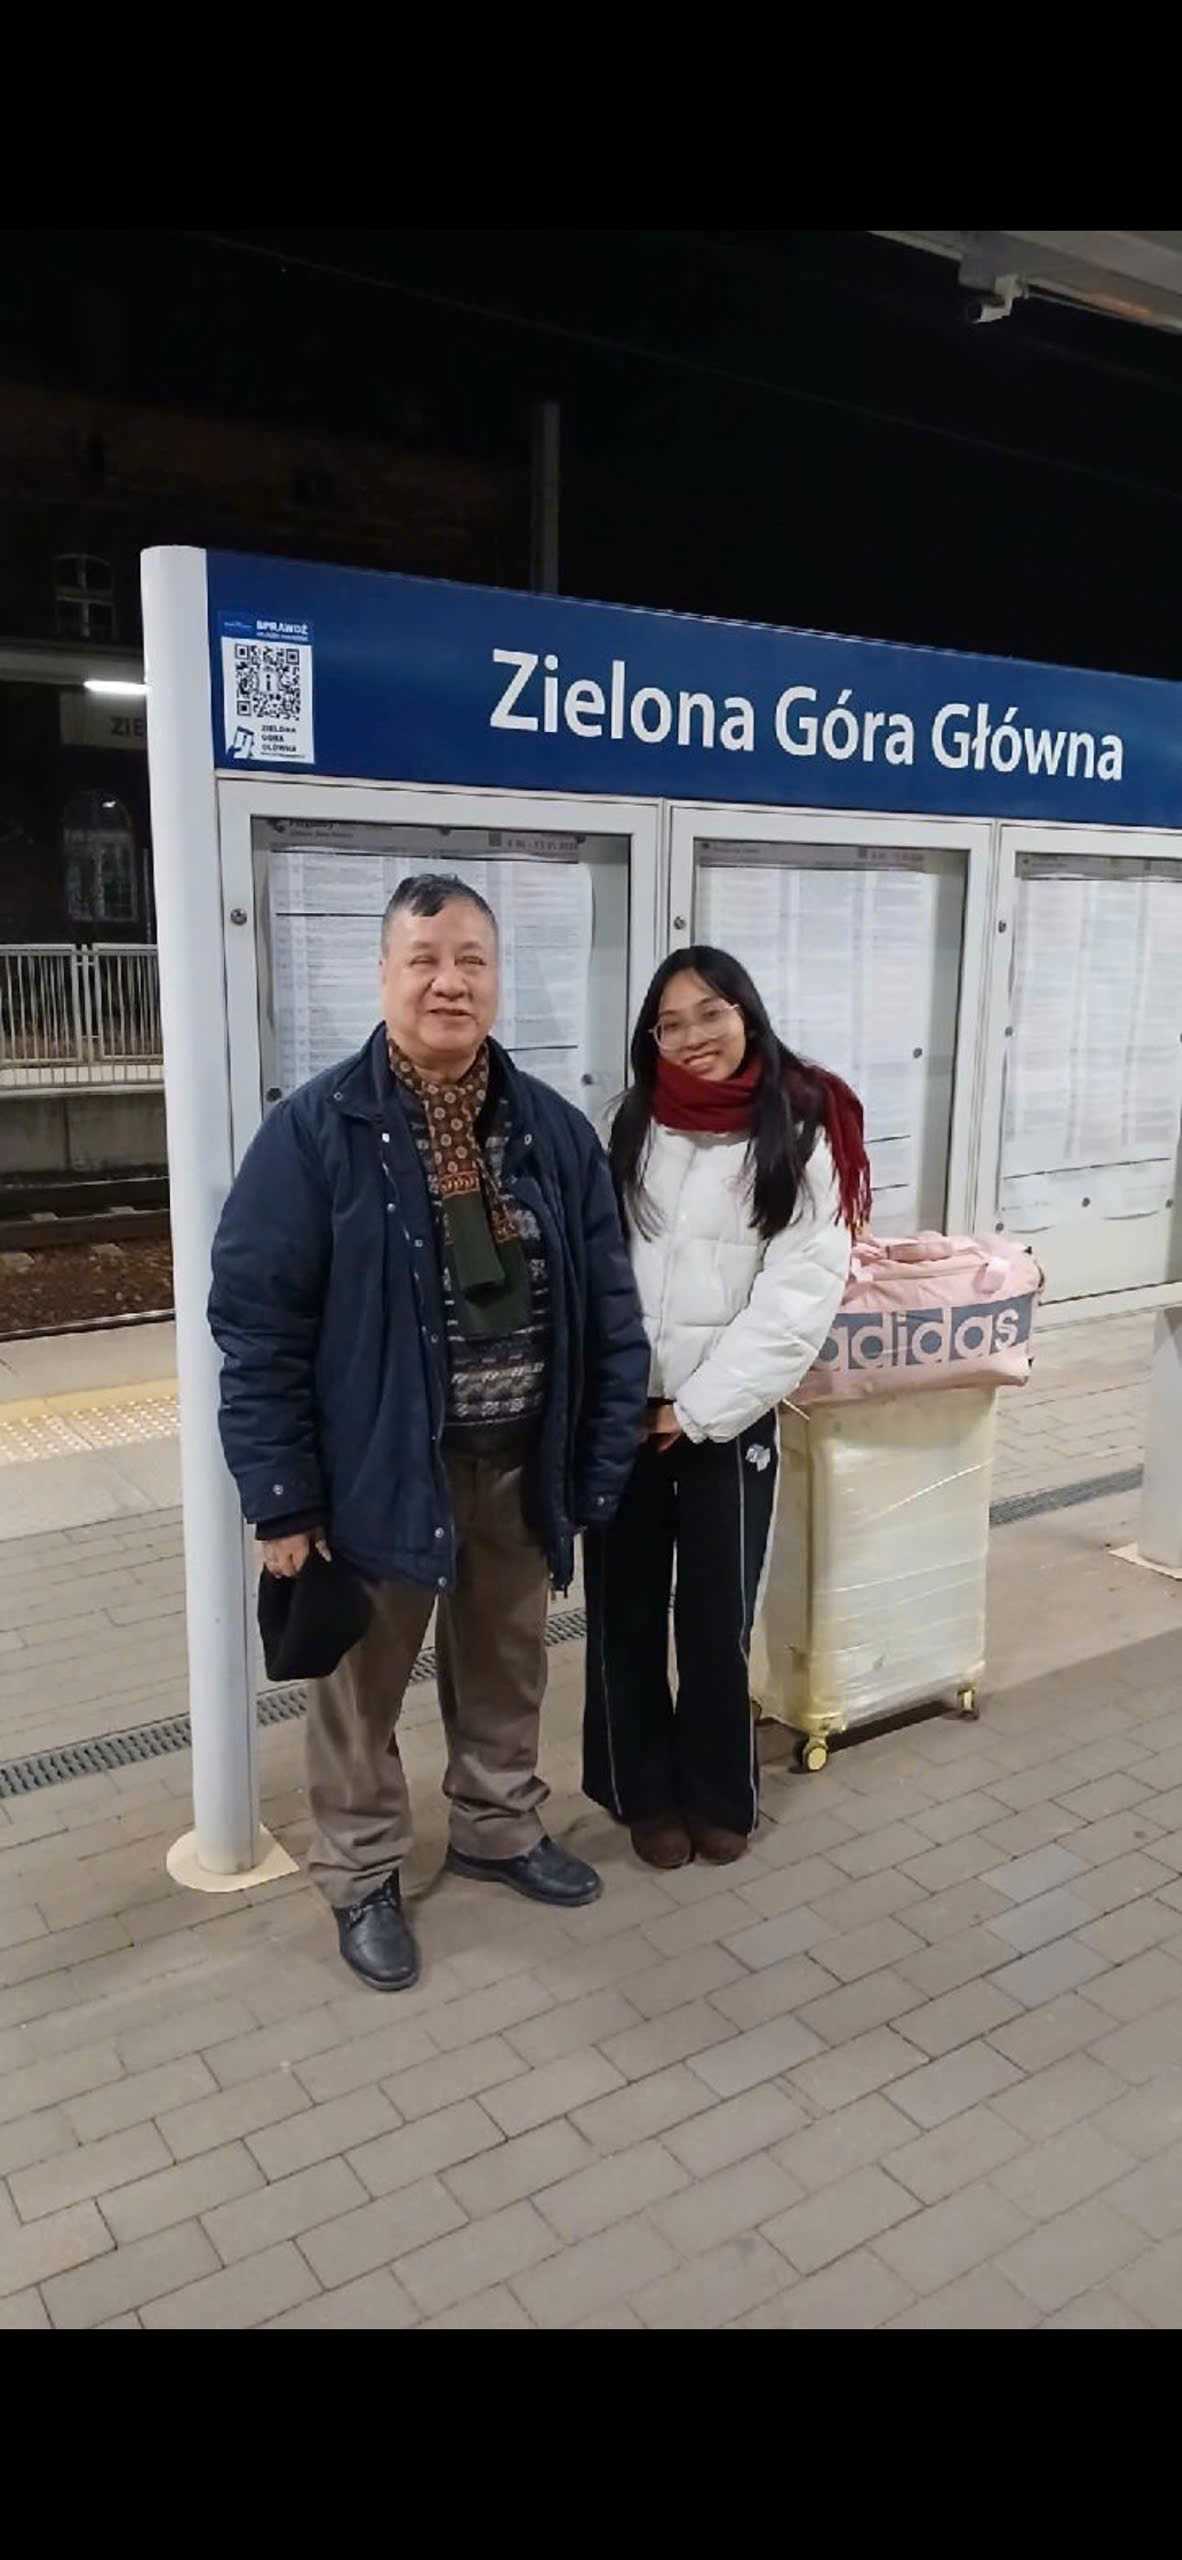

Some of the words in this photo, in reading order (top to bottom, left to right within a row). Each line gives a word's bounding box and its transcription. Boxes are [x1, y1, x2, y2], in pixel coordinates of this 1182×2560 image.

[490, 648, 754, 752] Zielona
[775, 685, 915, 766] Góra
[932, 702, 1124, 781] Główna
